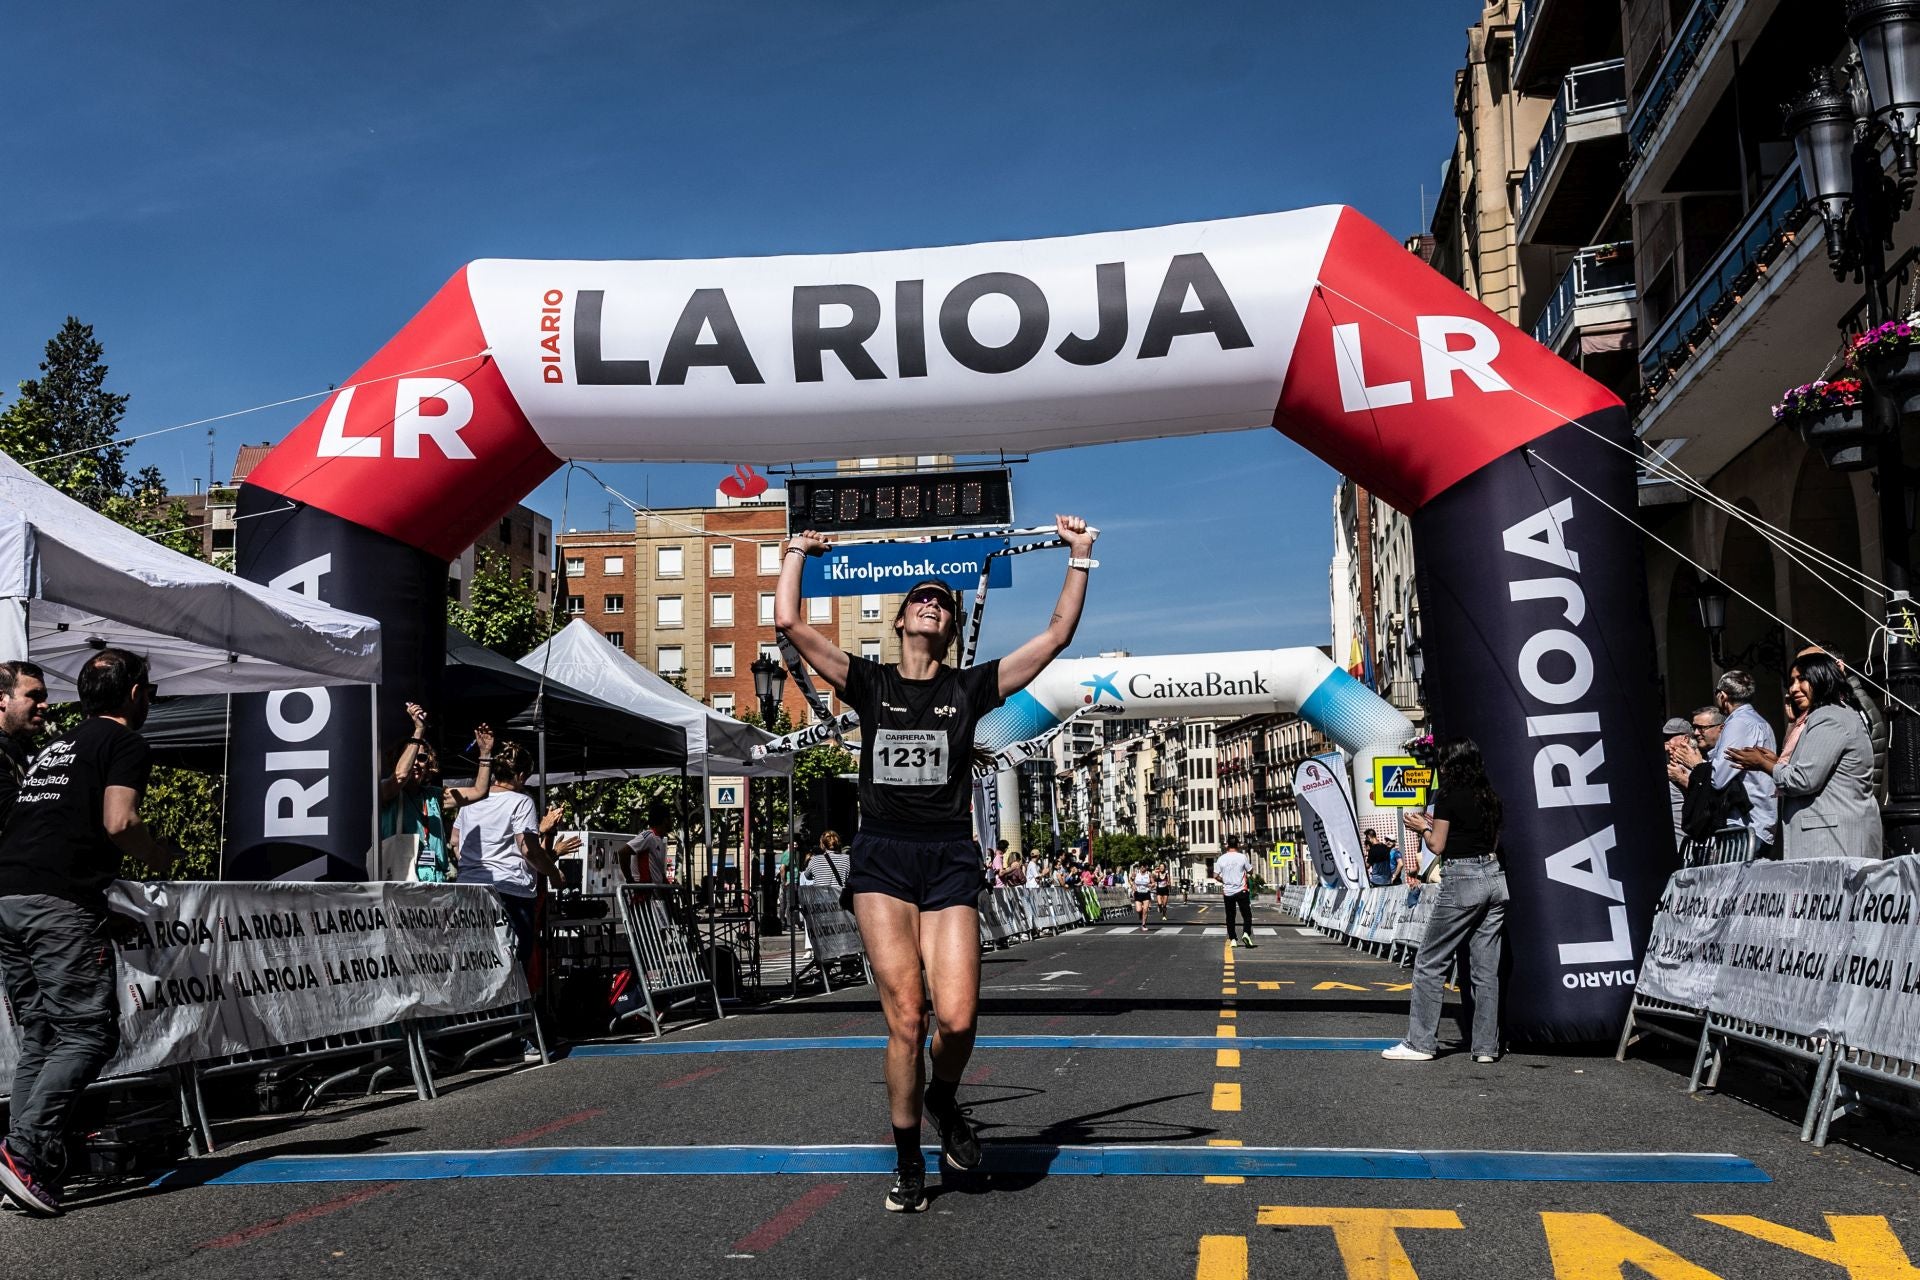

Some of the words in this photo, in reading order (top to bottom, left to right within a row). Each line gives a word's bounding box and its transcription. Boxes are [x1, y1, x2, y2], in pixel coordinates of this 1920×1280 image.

[543, 289, 564, 384] DIARIO
[573, 287, 765, 386] LA
[791, 252, 1255, 384] RIOJA
[1332, 315, 1513, 412] LR
[316, 377, 477, 459] LR
[832, 556, 978, 582] Kirolprobak.com
[1502, 496, 1612, 809] RIOJA
[264, 553, 331, 838] RIOA
[1128, 670, 1270, 699] CaixaBank
[885, 733, 925, 741] CARRERA
[878, 746, 942, 768] 1231
[1406, 777, 1430, 785] Marqu
[1545, 823, 1634, 965] LA
[1862, 894, 1911, 925] RIOJA
[154, 918, 215, 949] RIOJA
[225, 915, 253, 942] LA
[251, 912, 305, 940] RIOJA
[314, 910, 340, 935] LA
[339, 907, 388, 932] RIOJA
[237, 969, 266, 997] LA
[264, 964, 320, 994] RIOJA
[327, 960, 352, 986] LA
[350, 954, 401, 982] RIOJA
[1563, 969, 1636, 990] DIARIO
[1847, 955, 1894, 991] RIOJA
[135, 980, 169, 1011] LA
[167, 973, 226, 1008] RIOJA
